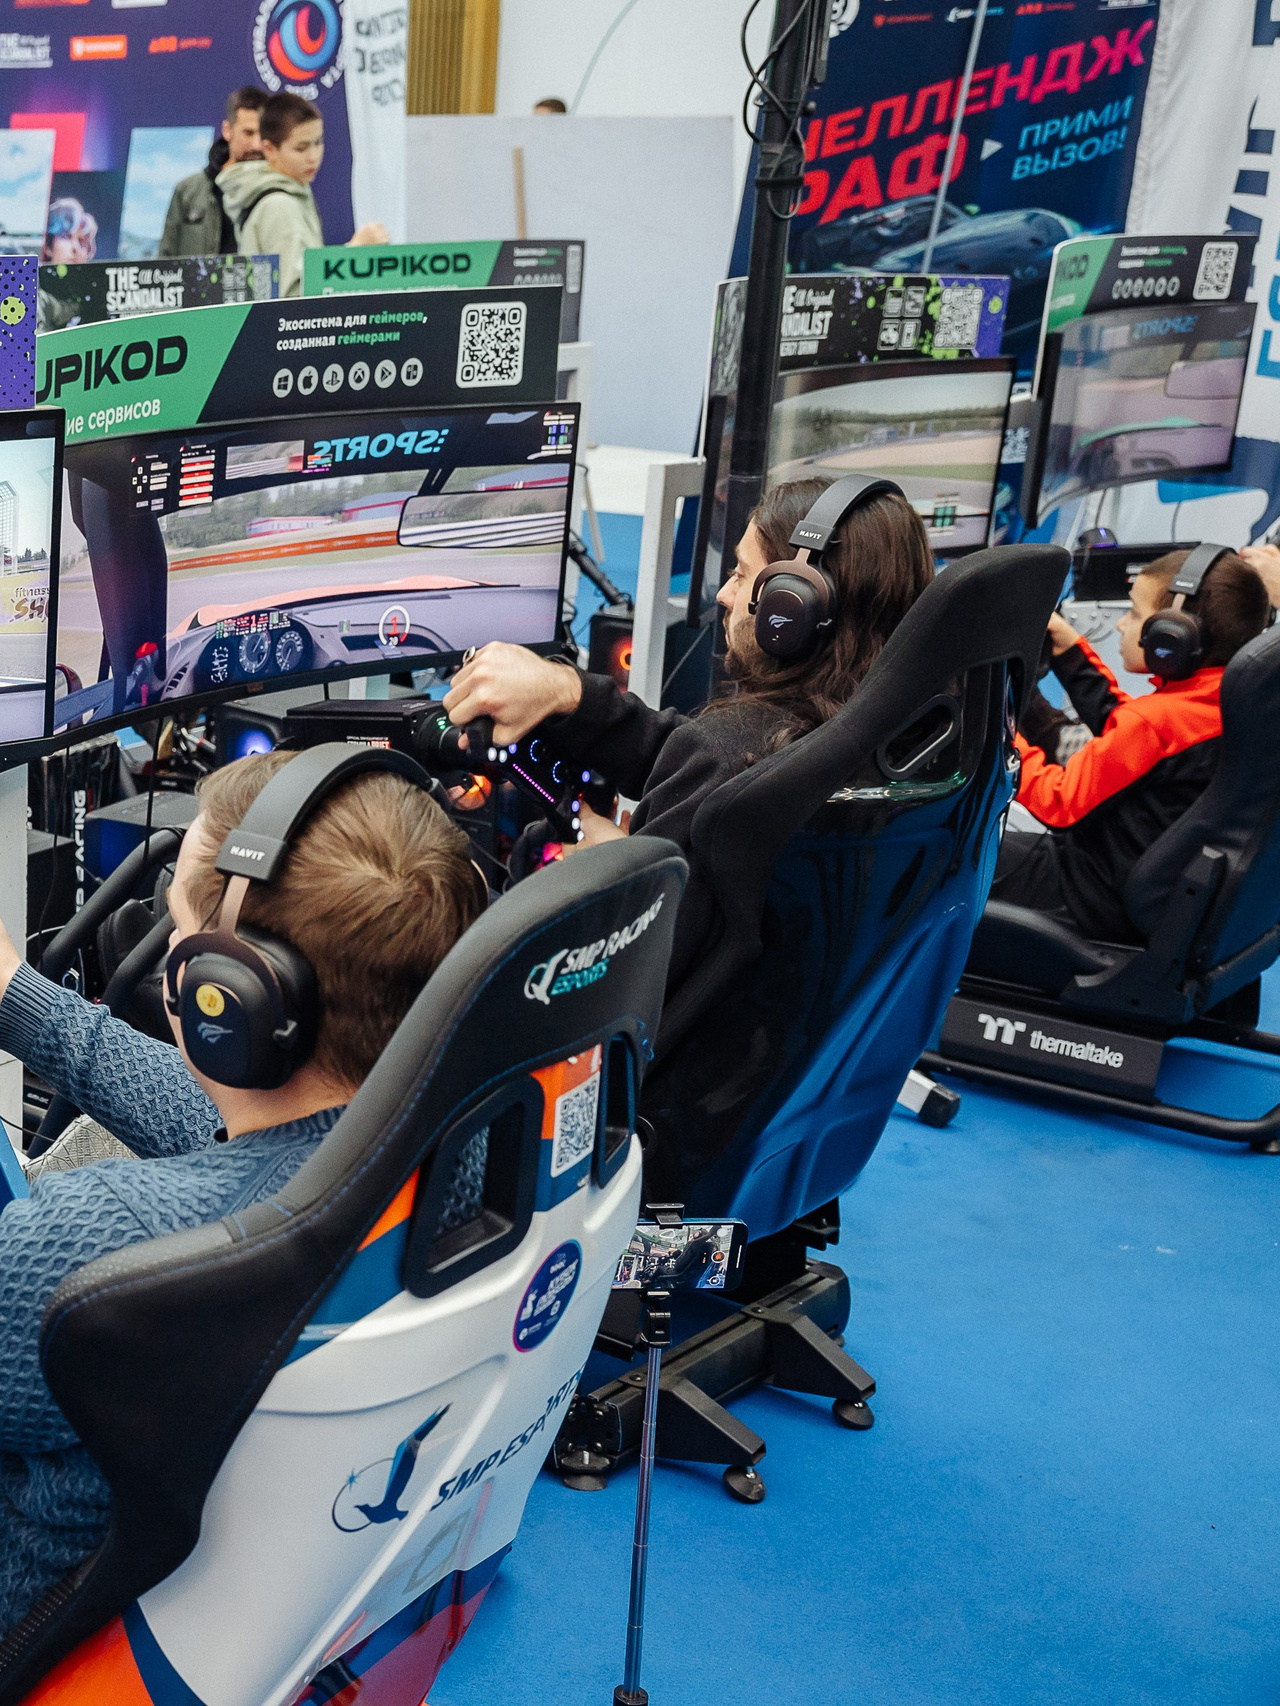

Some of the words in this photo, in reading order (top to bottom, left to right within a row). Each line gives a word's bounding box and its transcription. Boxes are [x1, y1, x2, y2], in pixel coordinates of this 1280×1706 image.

[1018, 95, 1135, 150] ПРИМИ
[1010, 127, 1128, 181] ВЫЗОВ!
[105, 267, 140, 291] THE
[324, 252, 471, 280] KUPIKOD
[277, 316, 343, 331] Экосистема
[344, 314, 367, 328] для
[276, 335, 336, 351] созданная
[337, 331, 401, 346] геймерами
[88, 399, 161, 433] сервисов
[799, 529, 822, 540] HAVIT
[230, 845, 266, 861] HAVIT
[1029, 1029, 1124, 1069] thermaltake
[430, 1449, 502, 1512] SMP
